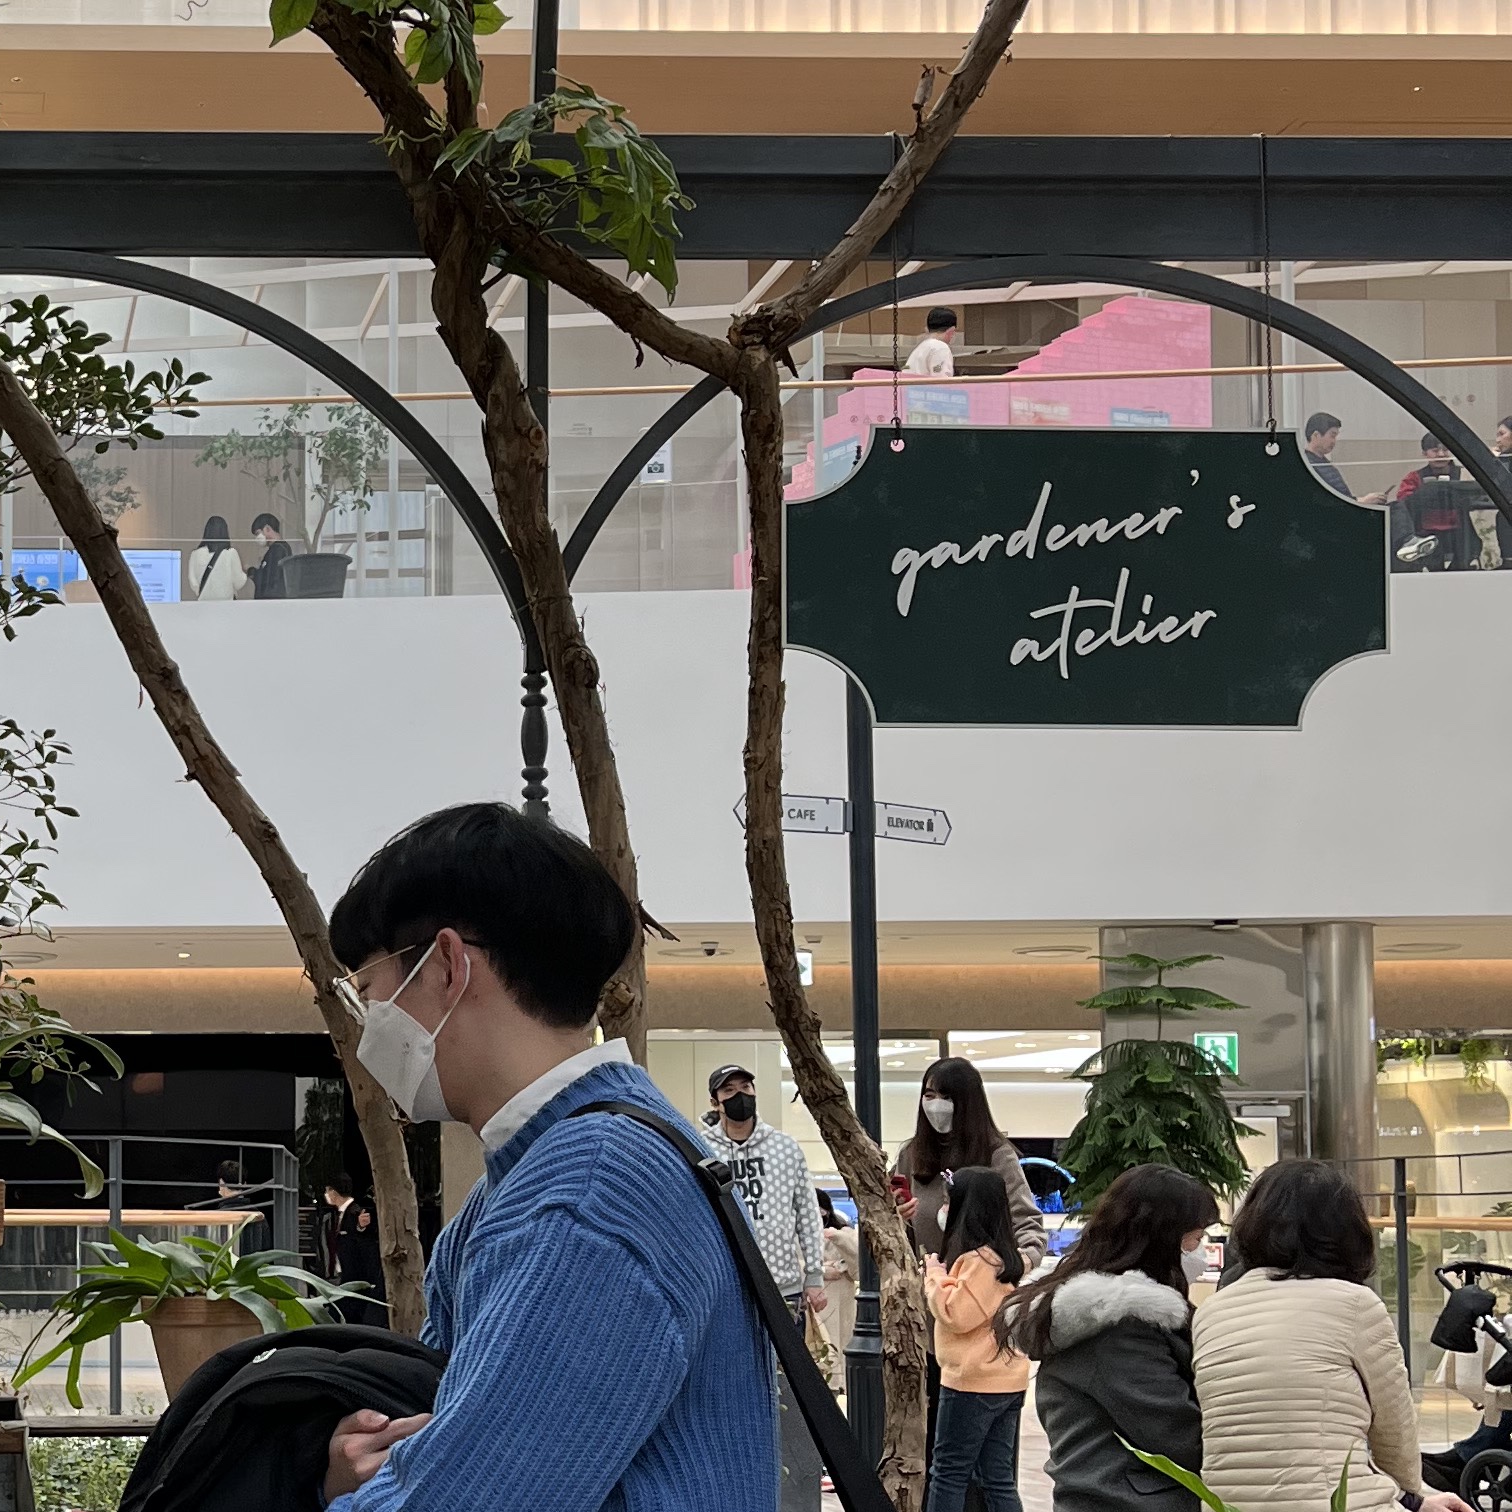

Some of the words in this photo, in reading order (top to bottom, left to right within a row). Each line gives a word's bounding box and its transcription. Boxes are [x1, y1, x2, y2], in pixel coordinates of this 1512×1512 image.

[890, 468, 1257, 617] gardener's
[1009, 566, 1217, 679] atelier
[788, 808, 816, 821] CAFE
[887, 816, 925, 831] ELEVATOR
[727, 1157, 765, 1178] UST
